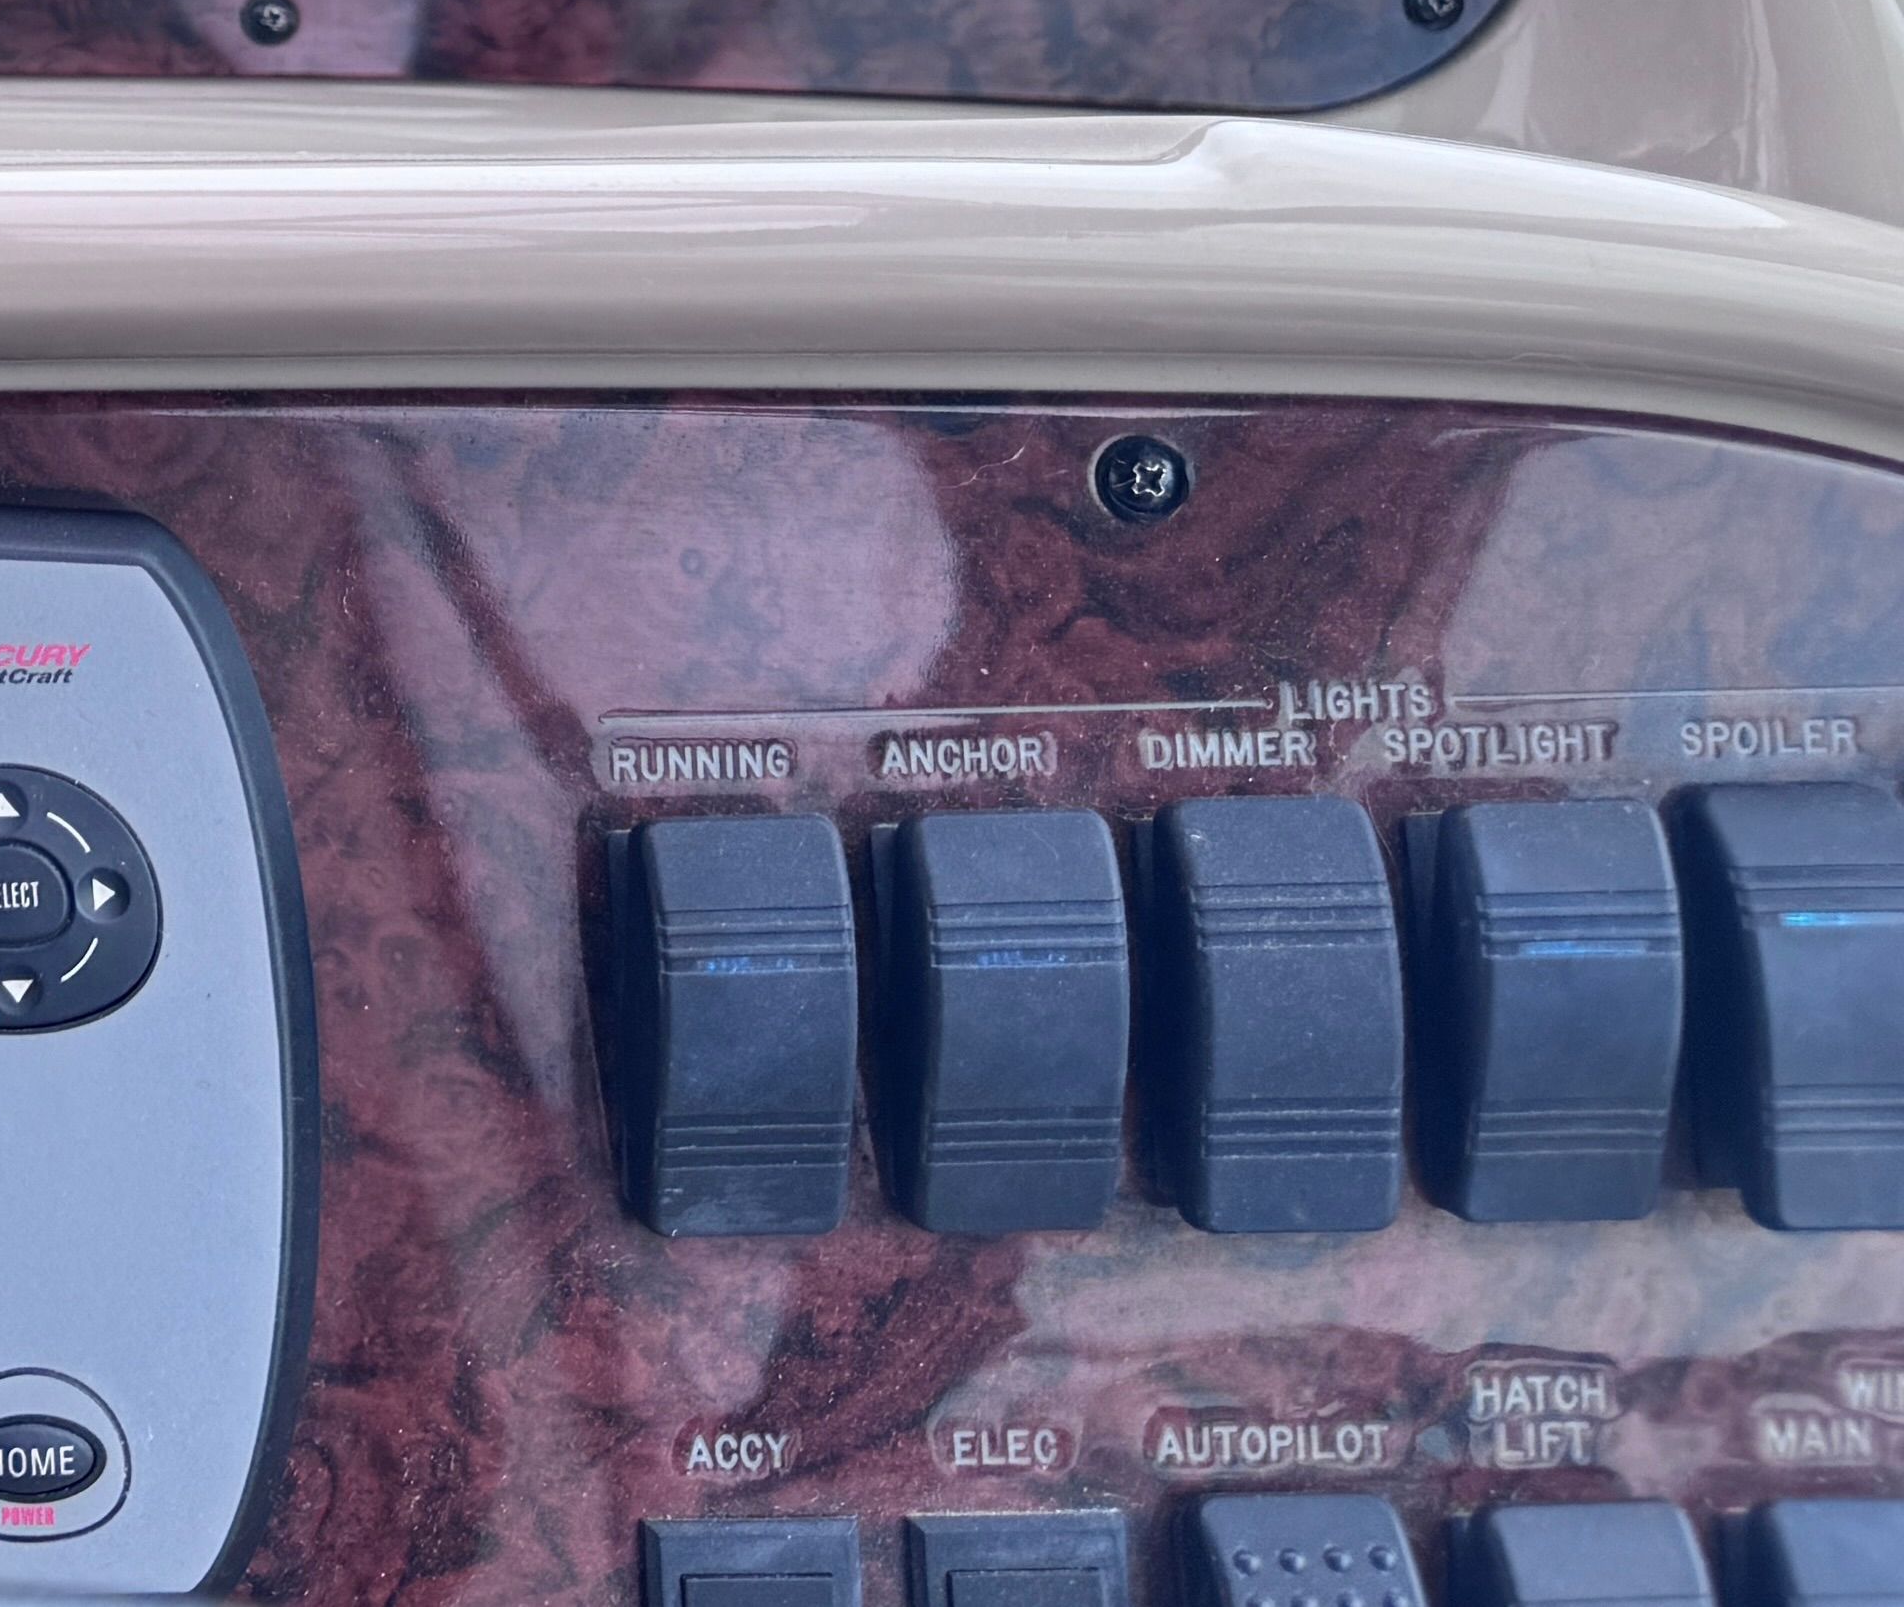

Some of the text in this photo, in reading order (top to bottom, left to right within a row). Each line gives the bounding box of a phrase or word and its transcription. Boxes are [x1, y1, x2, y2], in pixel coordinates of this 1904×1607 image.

[1288, 683, 1434, 721] LIGHTS
[881, 733, 1045, 776] ANCHOR
[1145, 728, 1316, 771] DIMMER
[1383, 723, 1616, 766] SPOTLIGHT
[1680, 718, 1860, 757] SPOILER
[611, 741, 791, 783] RUNNING
[1471, 1374, 1607, 1412] HATCH
[688, 1432, 790, 1471] ACCY
[953, 1428, 1059, 1467] ELEC
[1157, 1425, 1391, 1464] AUTOPILOT
[1497, 1420, 1591, 1460] LIFT
[1760, 1418, 1873, 1457] MAIN
[1, 1506, 56, 1526] POWER
